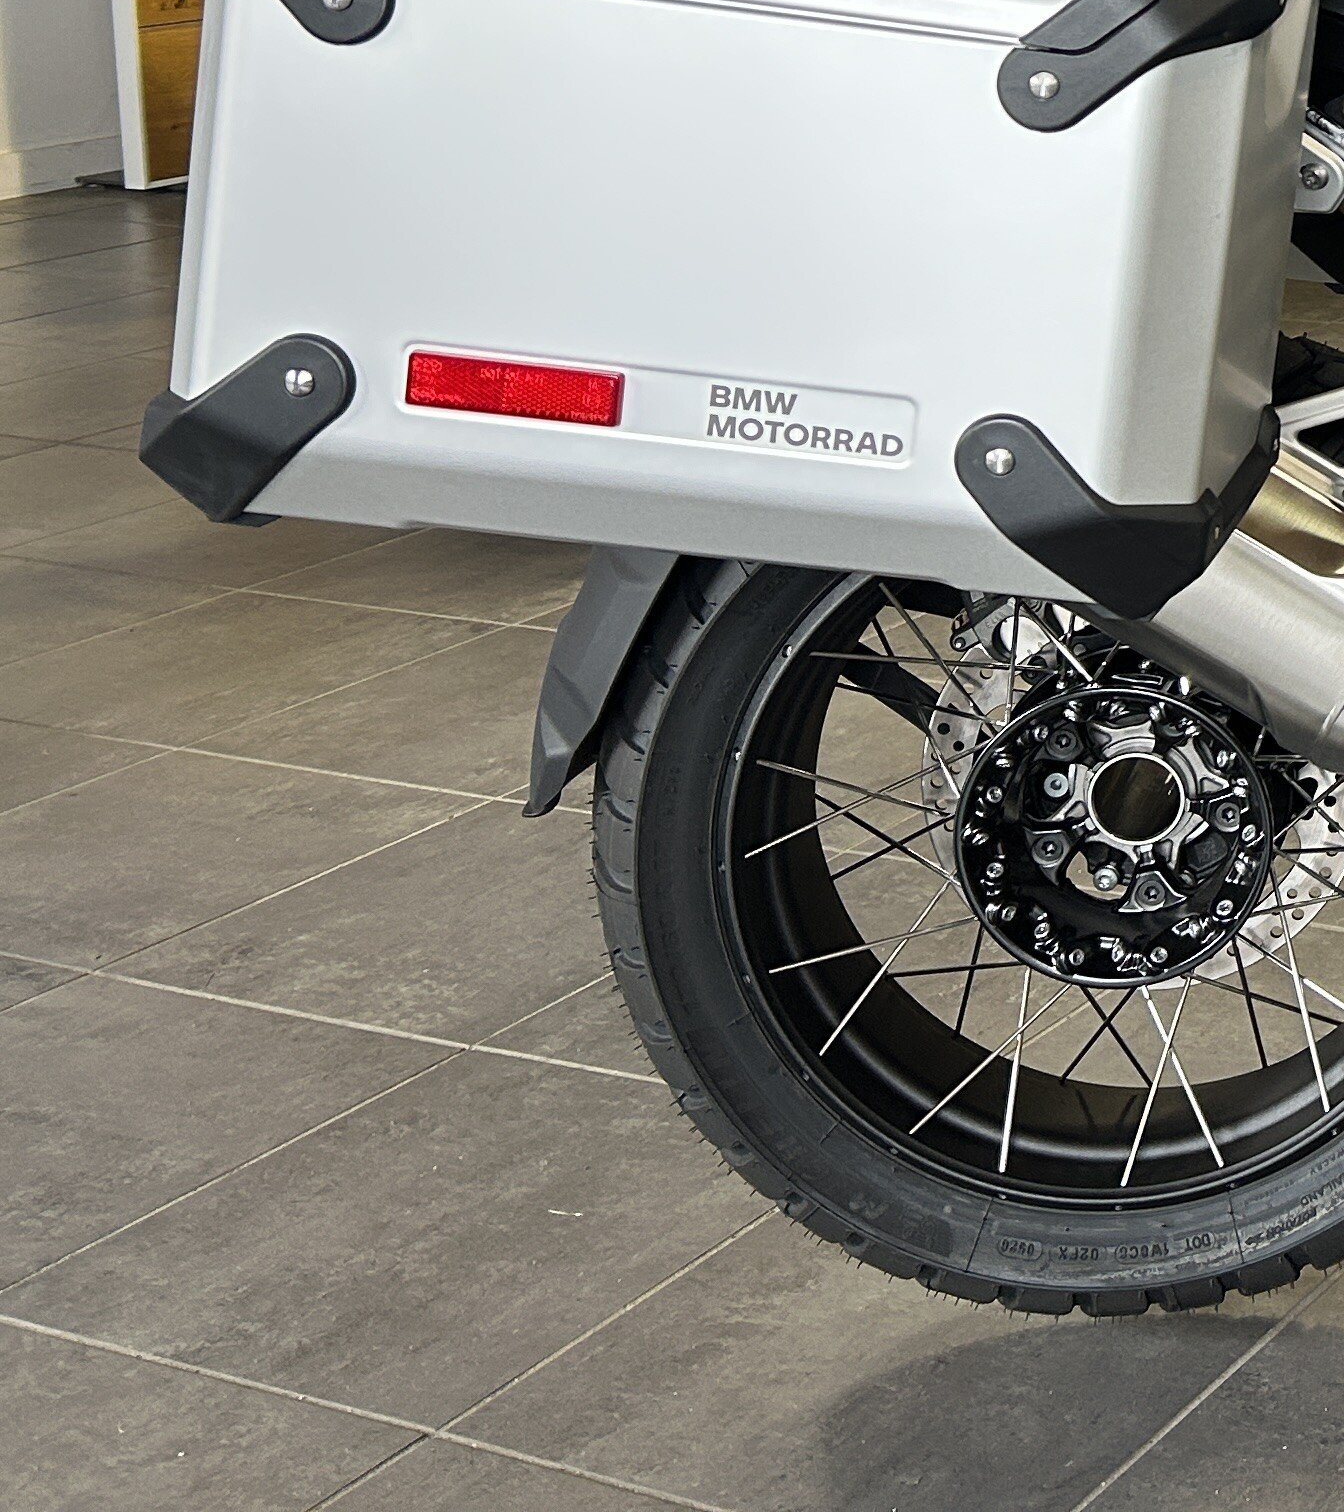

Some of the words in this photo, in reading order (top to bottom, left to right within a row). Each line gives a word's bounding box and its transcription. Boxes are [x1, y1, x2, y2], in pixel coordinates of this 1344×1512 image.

[709, 384, 799, 416] BMW
[706, 413, 904, 457] MOTORRAD
[1183, 1232, 1212, 1252] DOT
